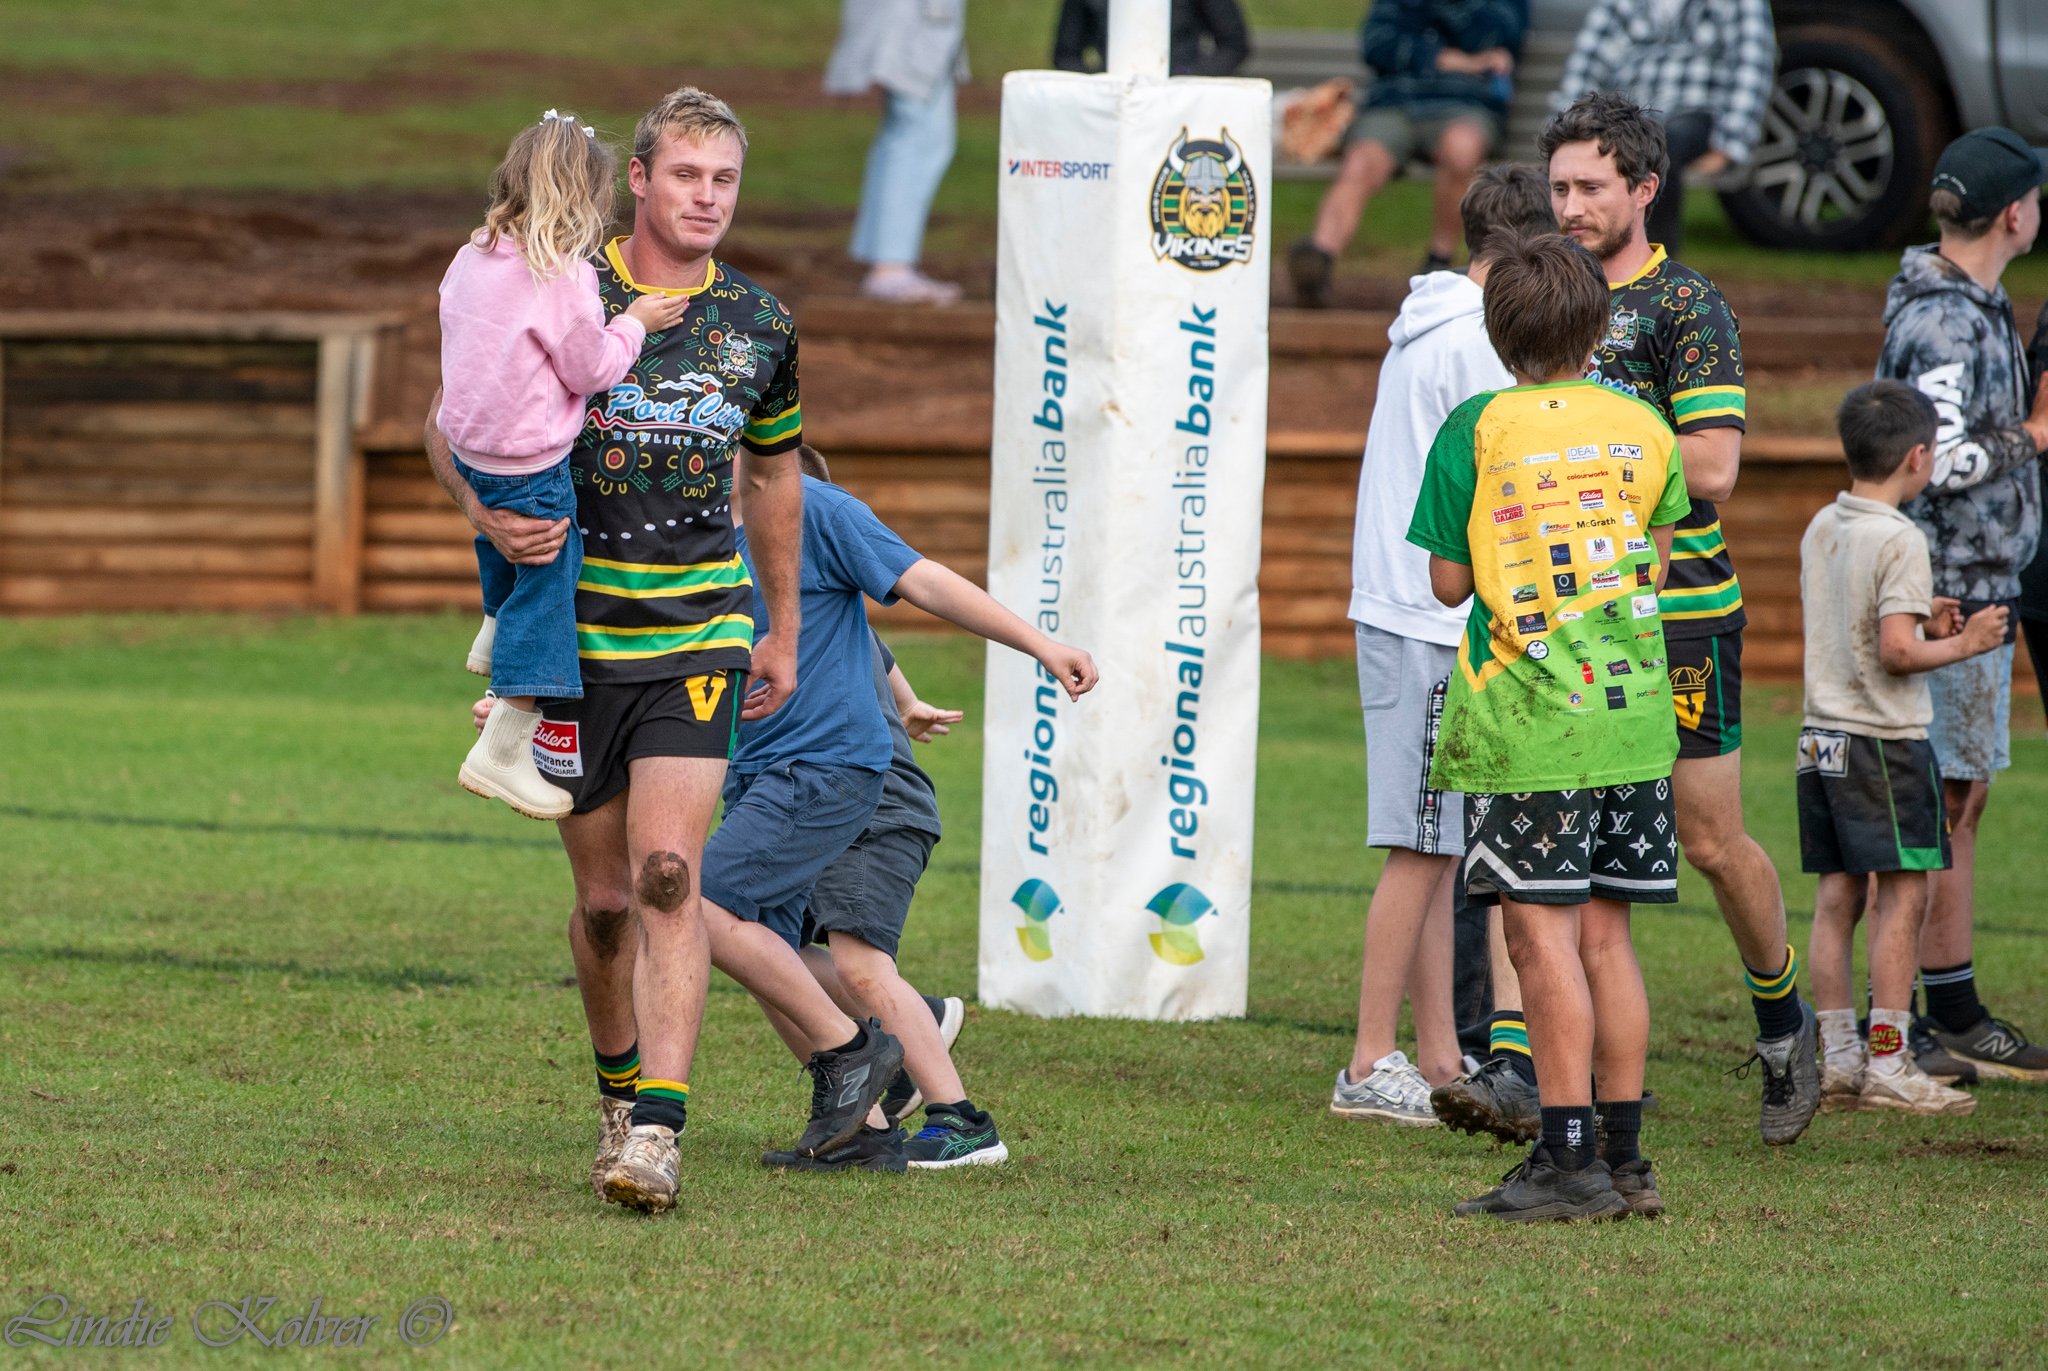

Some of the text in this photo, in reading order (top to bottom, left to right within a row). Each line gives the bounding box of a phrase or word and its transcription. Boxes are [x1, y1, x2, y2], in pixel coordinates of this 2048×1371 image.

[1020, 159, 1111, 181] INTERSPORT
[1152, 232, 1255, 263] VIKINGS
[720, 361, 756, 378] VIKINGS
[605, 383, 746, 437] Port City
[1548, 400, 1559, 409] 2
[613, 430, 694, 446] BOWLING
[1567, 445, 1598, 458] IDEAL
[1566, 470, 1609, 481] colourworks
[1580, 490, 1602, 501] Elders
[1494, 511, 1525, 524] GALORE
[1576, 517, 1617, 529] McGrath
